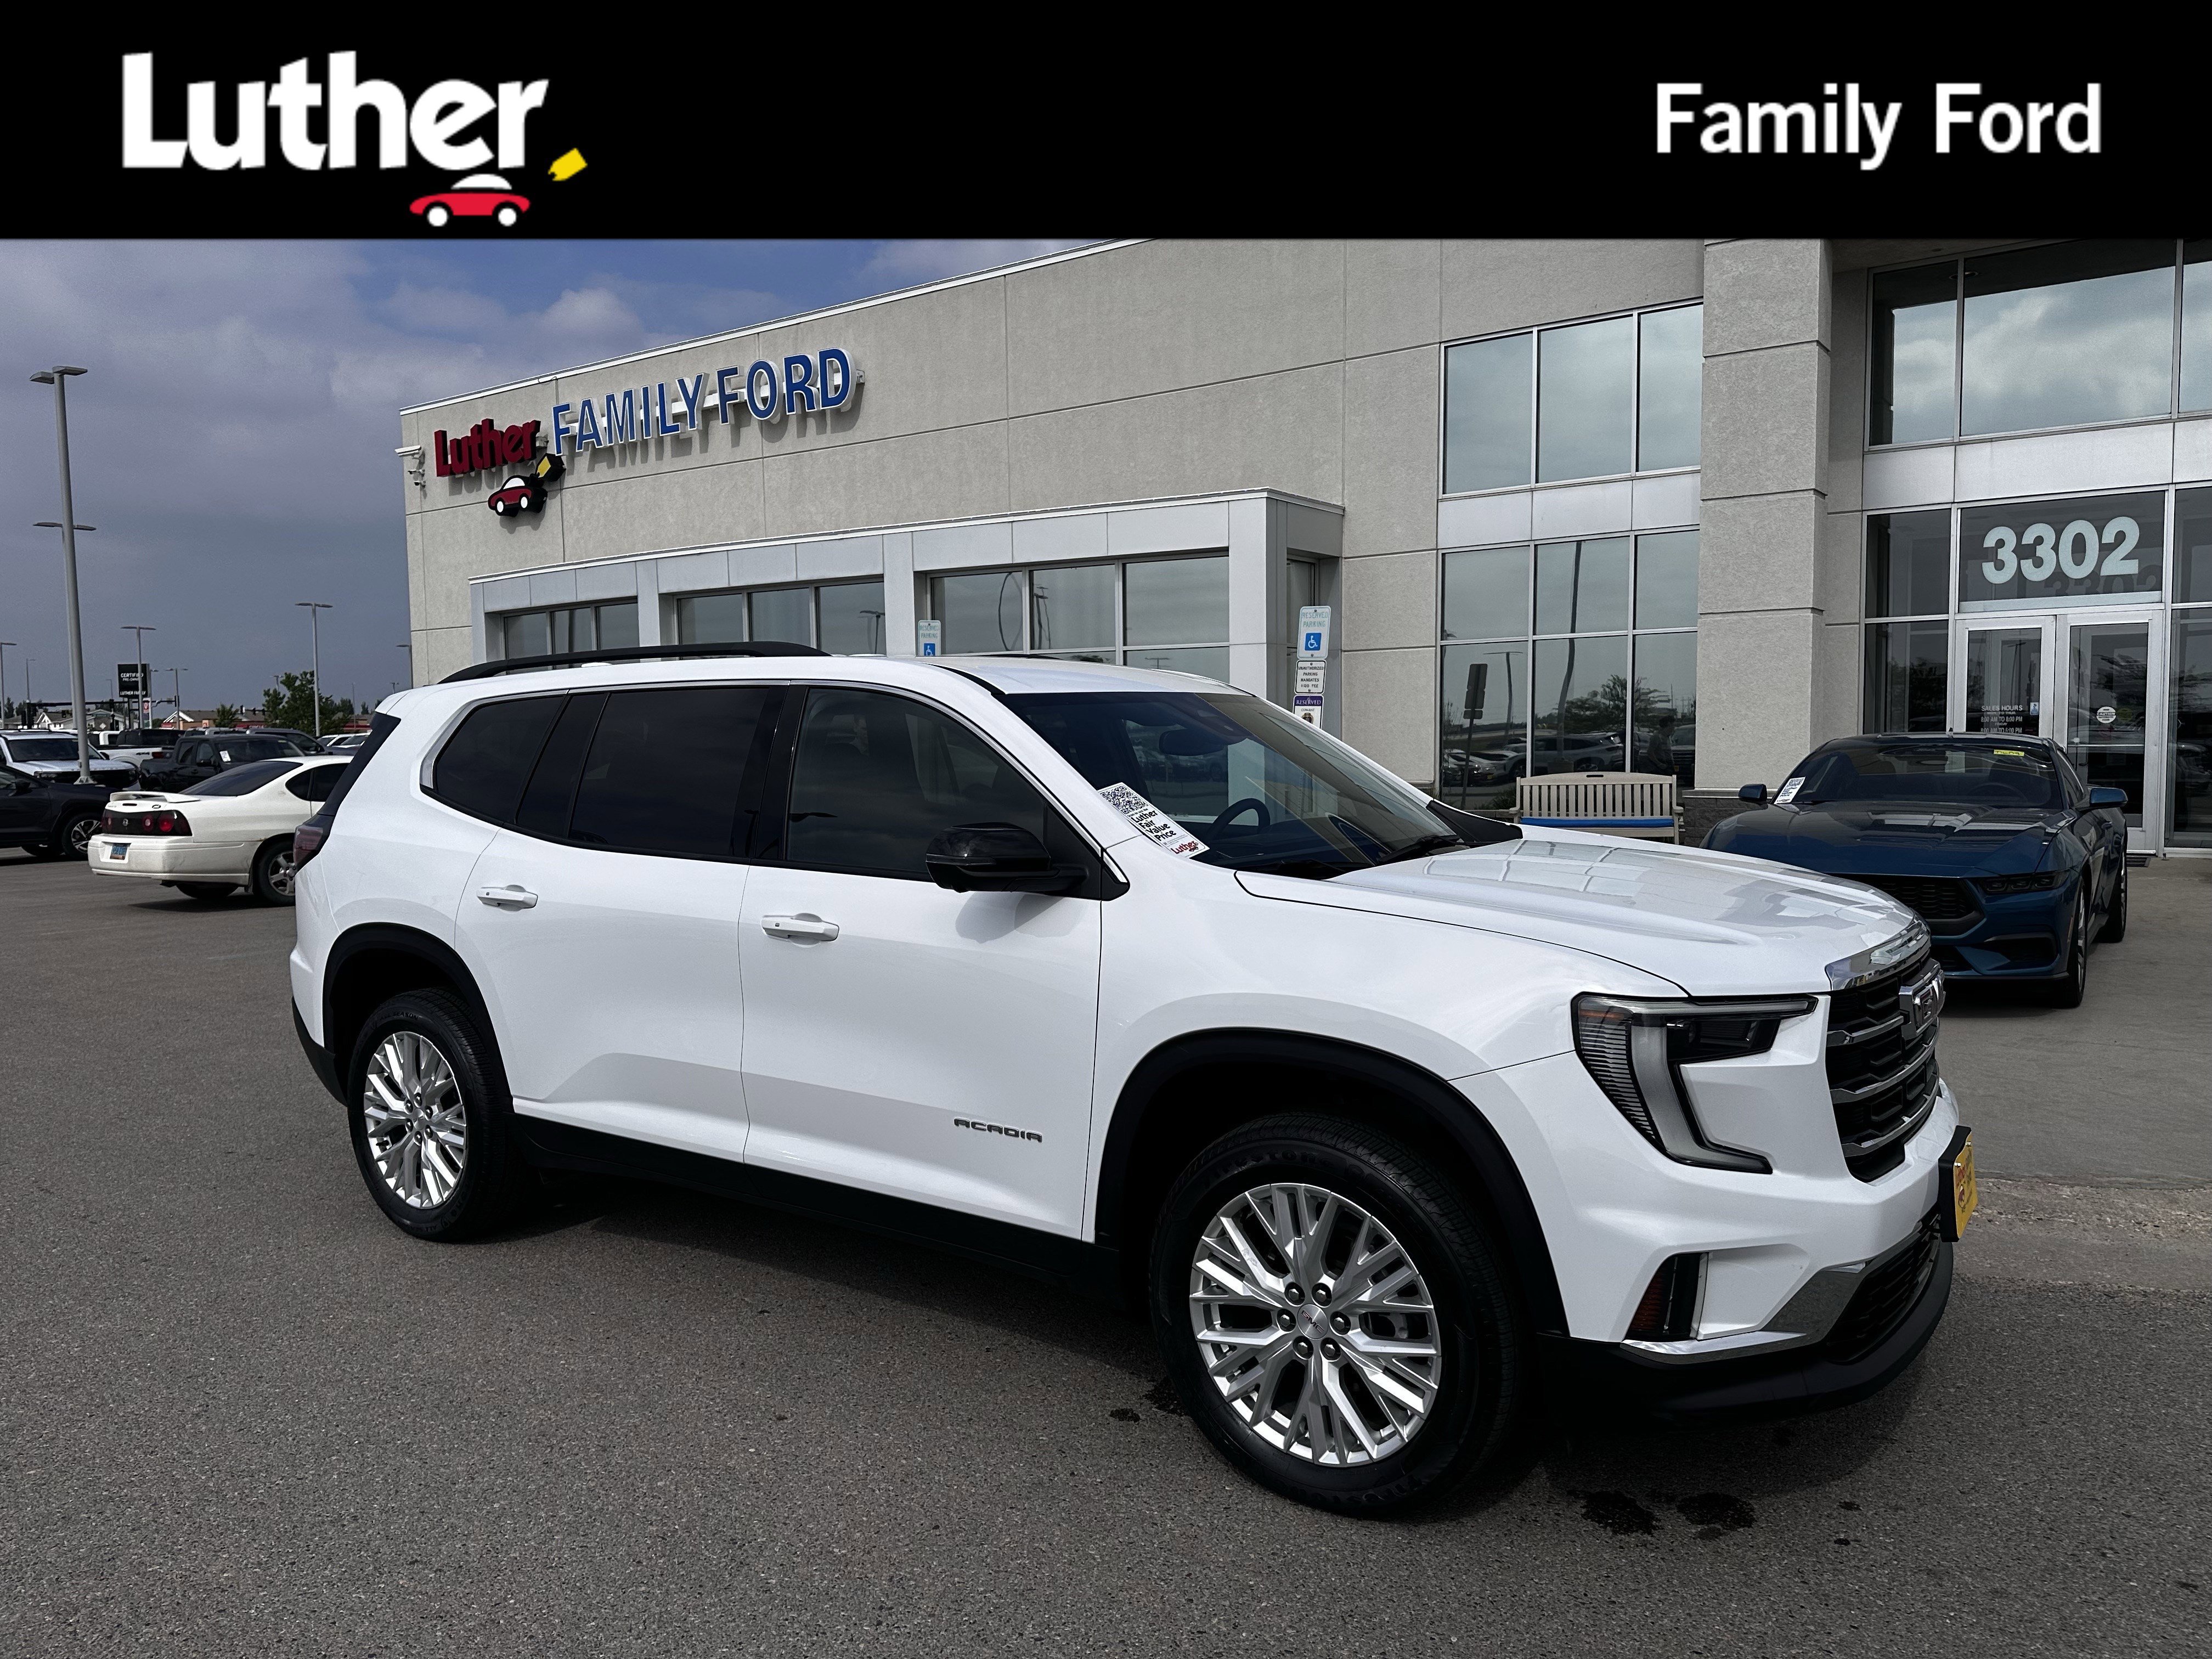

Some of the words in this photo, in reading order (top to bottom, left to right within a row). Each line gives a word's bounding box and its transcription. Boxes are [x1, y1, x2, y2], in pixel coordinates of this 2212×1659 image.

[552, 373, 707, 456] FAMILY
[716, 348, 855, 425] FORD
[435, 418, 541, 477] Luther
[1982, 516, 2140, 584] 3302
[1130, 810, 1158, 823] Luther
[1138, 820, 1156, 829] Fair
[1146, 823, 1171, 834] Value
[1154, 830, 1177, 842] Price
[1170, 840, 1197, 854] Luther
[953, 1117, 1042, 1143] ACADIA
[1301, 1310, 1325, 1335] GMC
